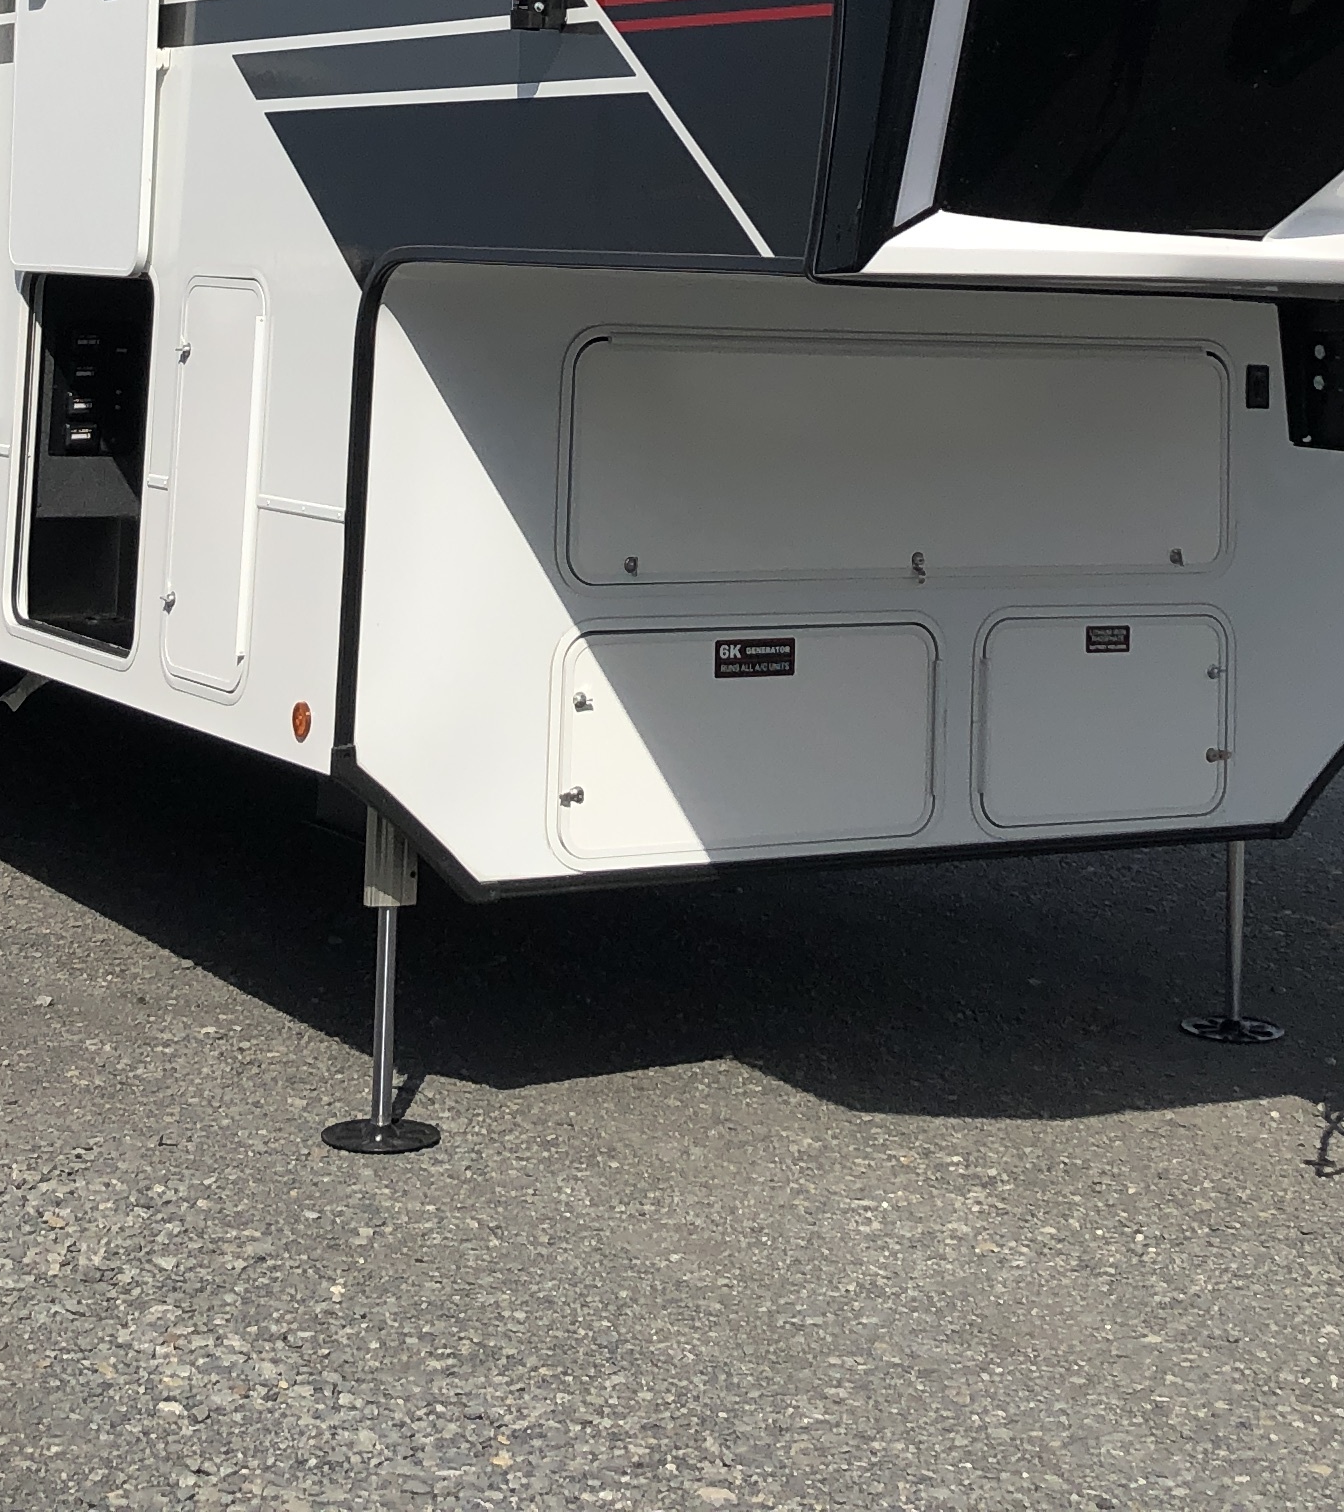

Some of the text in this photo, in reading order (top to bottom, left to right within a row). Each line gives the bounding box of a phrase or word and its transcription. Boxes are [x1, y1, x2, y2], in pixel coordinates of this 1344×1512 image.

[719, 644, 791, 659] 6K GENERATOR
[740, 663, 754, 672] ALL
